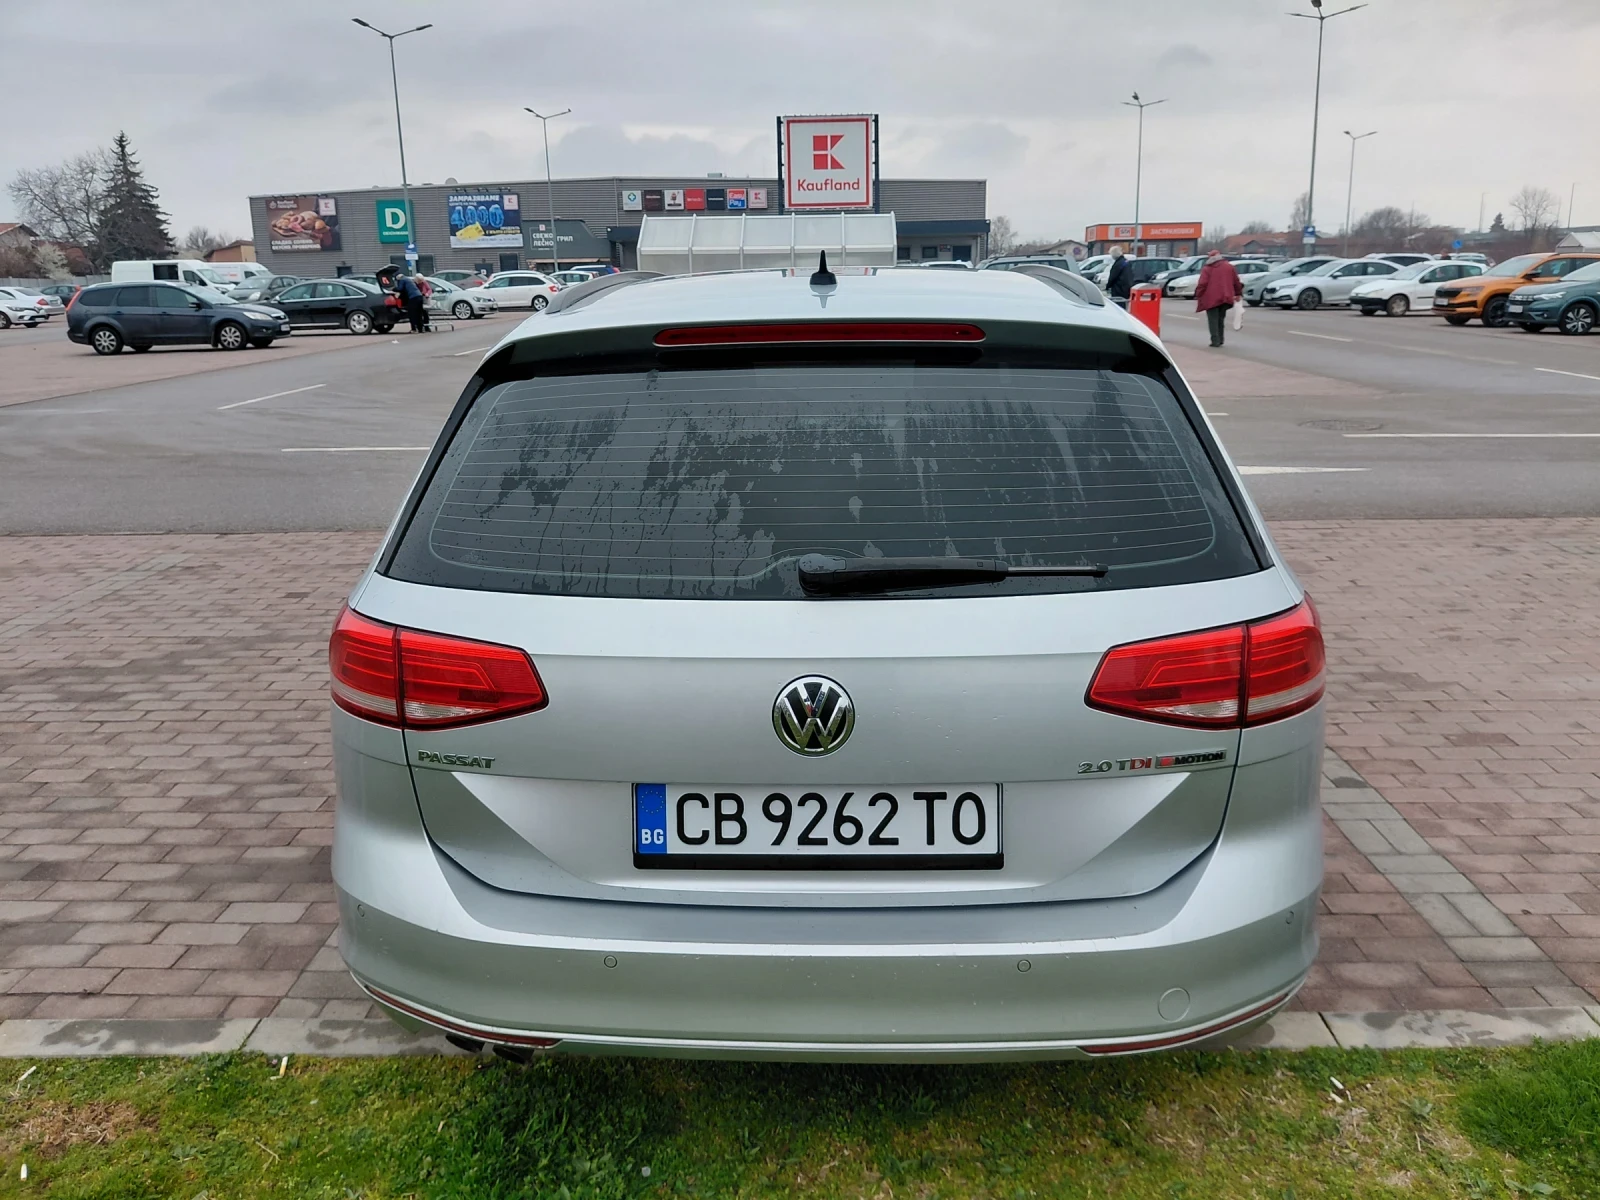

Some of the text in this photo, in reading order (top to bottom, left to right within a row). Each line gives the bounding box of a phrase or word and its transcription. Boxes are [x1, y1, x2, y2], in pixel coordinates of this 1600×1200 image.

[797, 178, 860, 192] Kaufland
[729, 199, 742, 207] Pay
[385, 207, 406, 229] D
[450, 204, 504, 229] 4000
[418, 749, 495, 769] PASSAT
[1116, 757, 1152, 770] TDI
[676, 791, 986, 846] CB 9262 TO
[641, 828, 664, 845] BG
